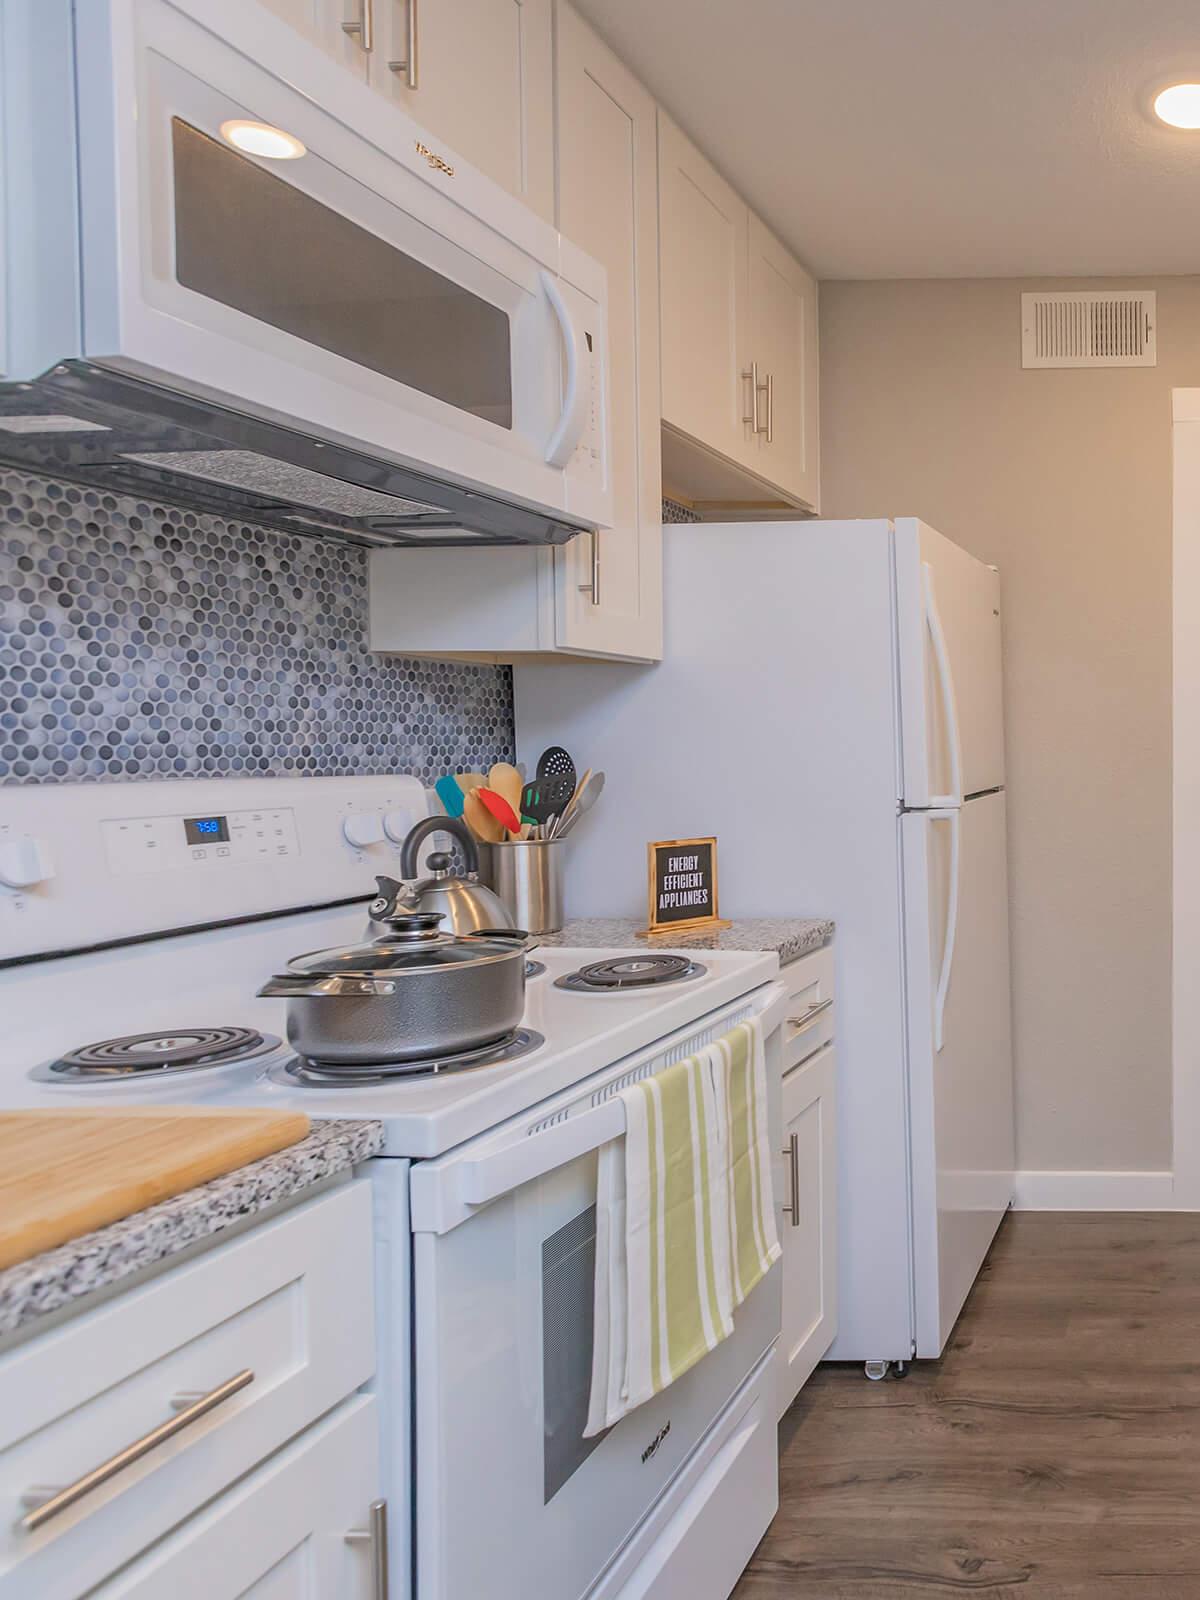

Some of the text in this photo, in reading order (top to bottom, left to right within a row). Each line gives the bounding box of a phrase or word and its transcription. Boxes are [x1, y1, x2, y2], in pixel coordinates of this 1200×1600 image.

[668, 855, 699, 873] ENERGY
[663, 872, 704, 891] EFFICIENT
[659, 888, 708, 909] APPLIANCES
